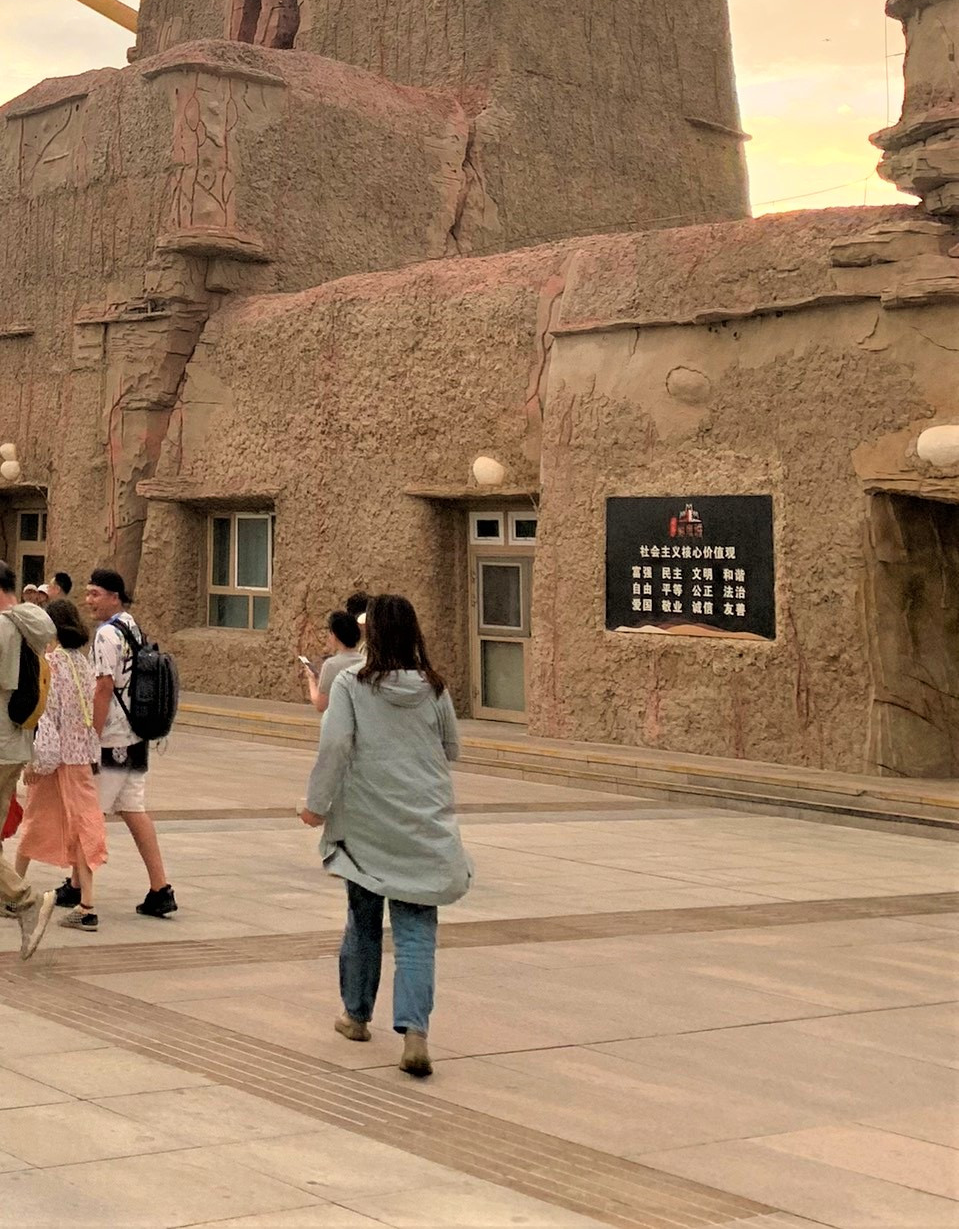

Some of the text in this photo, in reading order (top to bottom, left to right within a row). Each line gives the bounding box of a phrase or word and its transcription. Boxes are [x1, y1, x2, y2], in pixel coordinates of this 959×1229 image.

[639, 545, 736, 559] 社会主义核心价值观
[631, 565, 746, 582] 富强 民主 文明 和谐
[632, 582, 746, 599] 自由 平等 公正 法治
[631, 598, 746, 617] 爱国 敬业 诚信 友善
